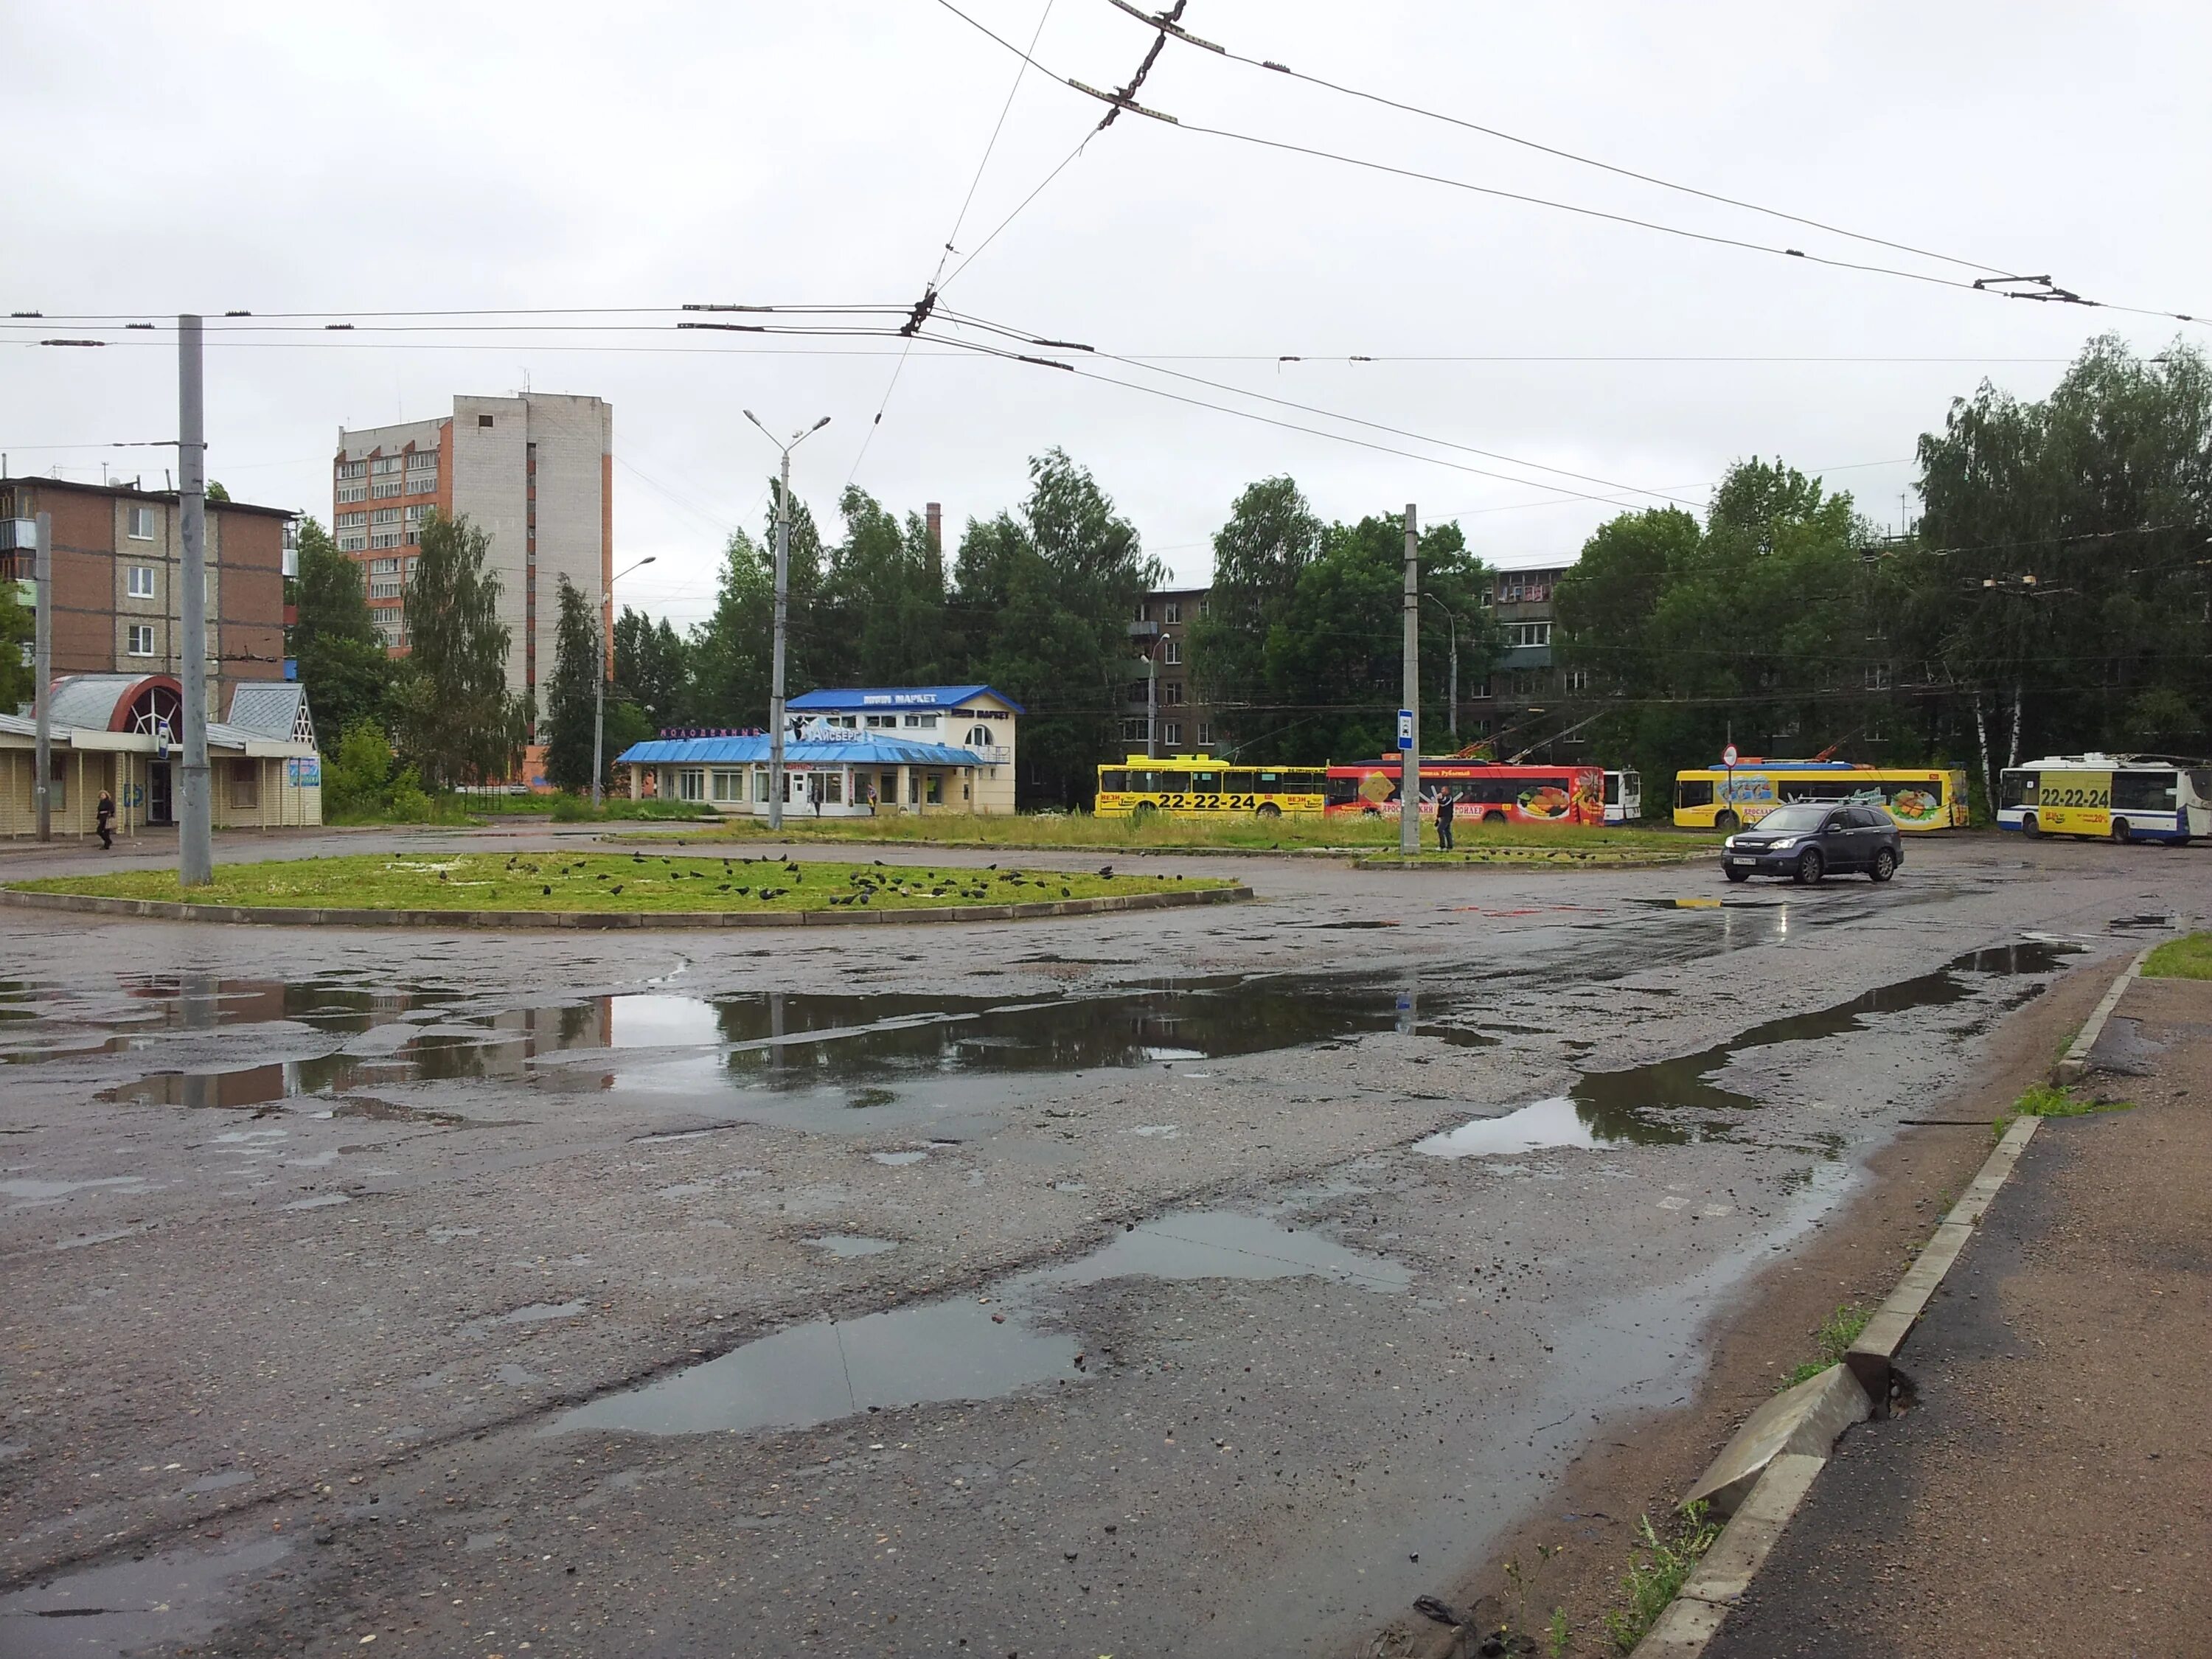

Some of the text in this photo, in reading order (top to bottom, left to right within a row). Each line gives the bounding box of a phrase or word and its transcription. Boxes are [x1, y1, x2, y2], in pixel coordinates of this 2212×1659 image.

[895, 694, 937, 703] МАРКЕТ
[1158, 794, 1256, 809] 22-22-24
[2041, 788, 2109, 809] 22-22-24
